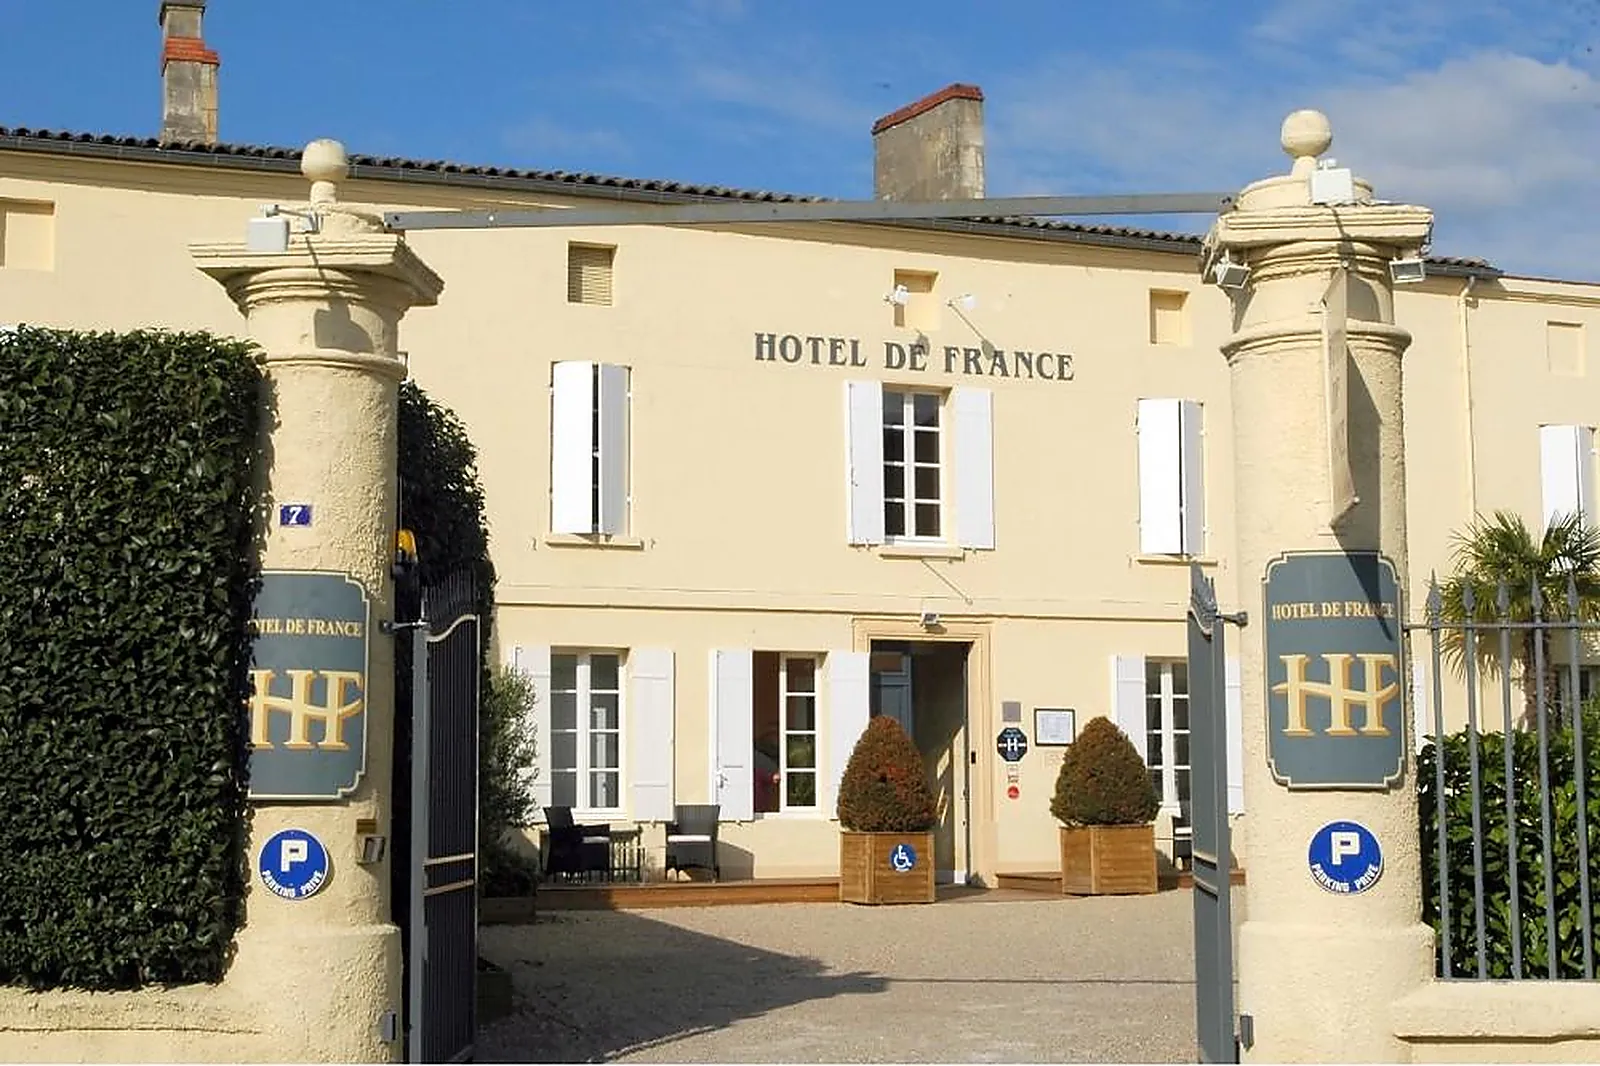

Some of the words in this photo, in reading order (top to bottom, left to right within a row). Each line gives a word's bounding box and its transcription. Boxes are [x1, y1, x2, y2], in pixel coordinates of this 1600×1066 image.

[754, 332, 867, 367] HOTEL
[883, 341, 928, 372] DE
[943, 345, 1075, 382] FRANCE
[289, 506, 303, 524] 7
[1272, 602, 1319, 620] HOTEL
[1321, 601, 1342, 618] DE
[1344, 601, 1395, 619] FRANCE
[286, 618, 305, 635] DE
[307, 618, 363, 638] FRANCE
[281, 839, 308, 873] P
[1331, 831, 1360, 865] P
[262, 869, 296, 898] PARKING
[1311, 863, 1350, 892] PARKING
